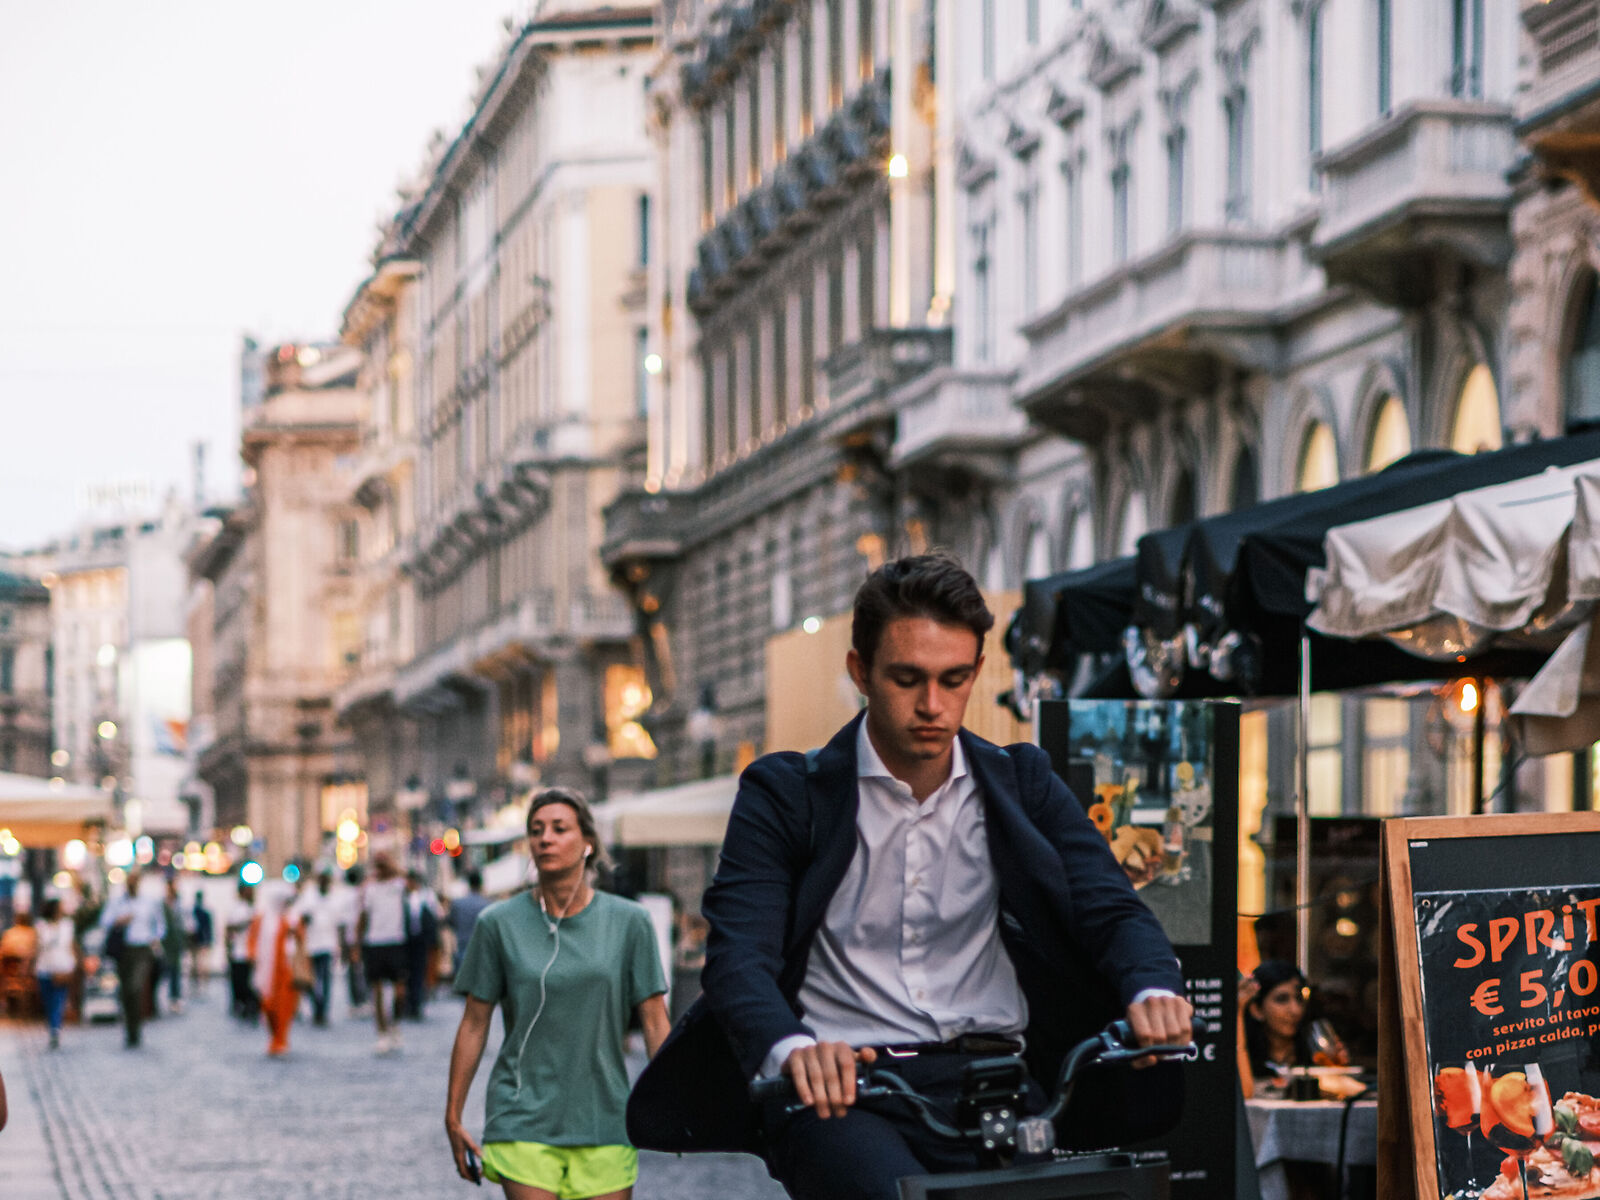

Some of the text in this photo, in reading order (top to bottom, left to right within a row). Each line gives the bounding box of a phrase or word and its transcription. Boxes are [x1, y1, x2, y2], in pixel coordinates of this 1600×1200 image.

[1470, 978, 1504, 1015] €
[1493, 1006, 1600, 1036] servito al tavo
[1466, 1046, 1492, 1060] con
[1496, 1036, 1536, 1056] pizza
[1539, 1026, 1585, 1044] calda,
